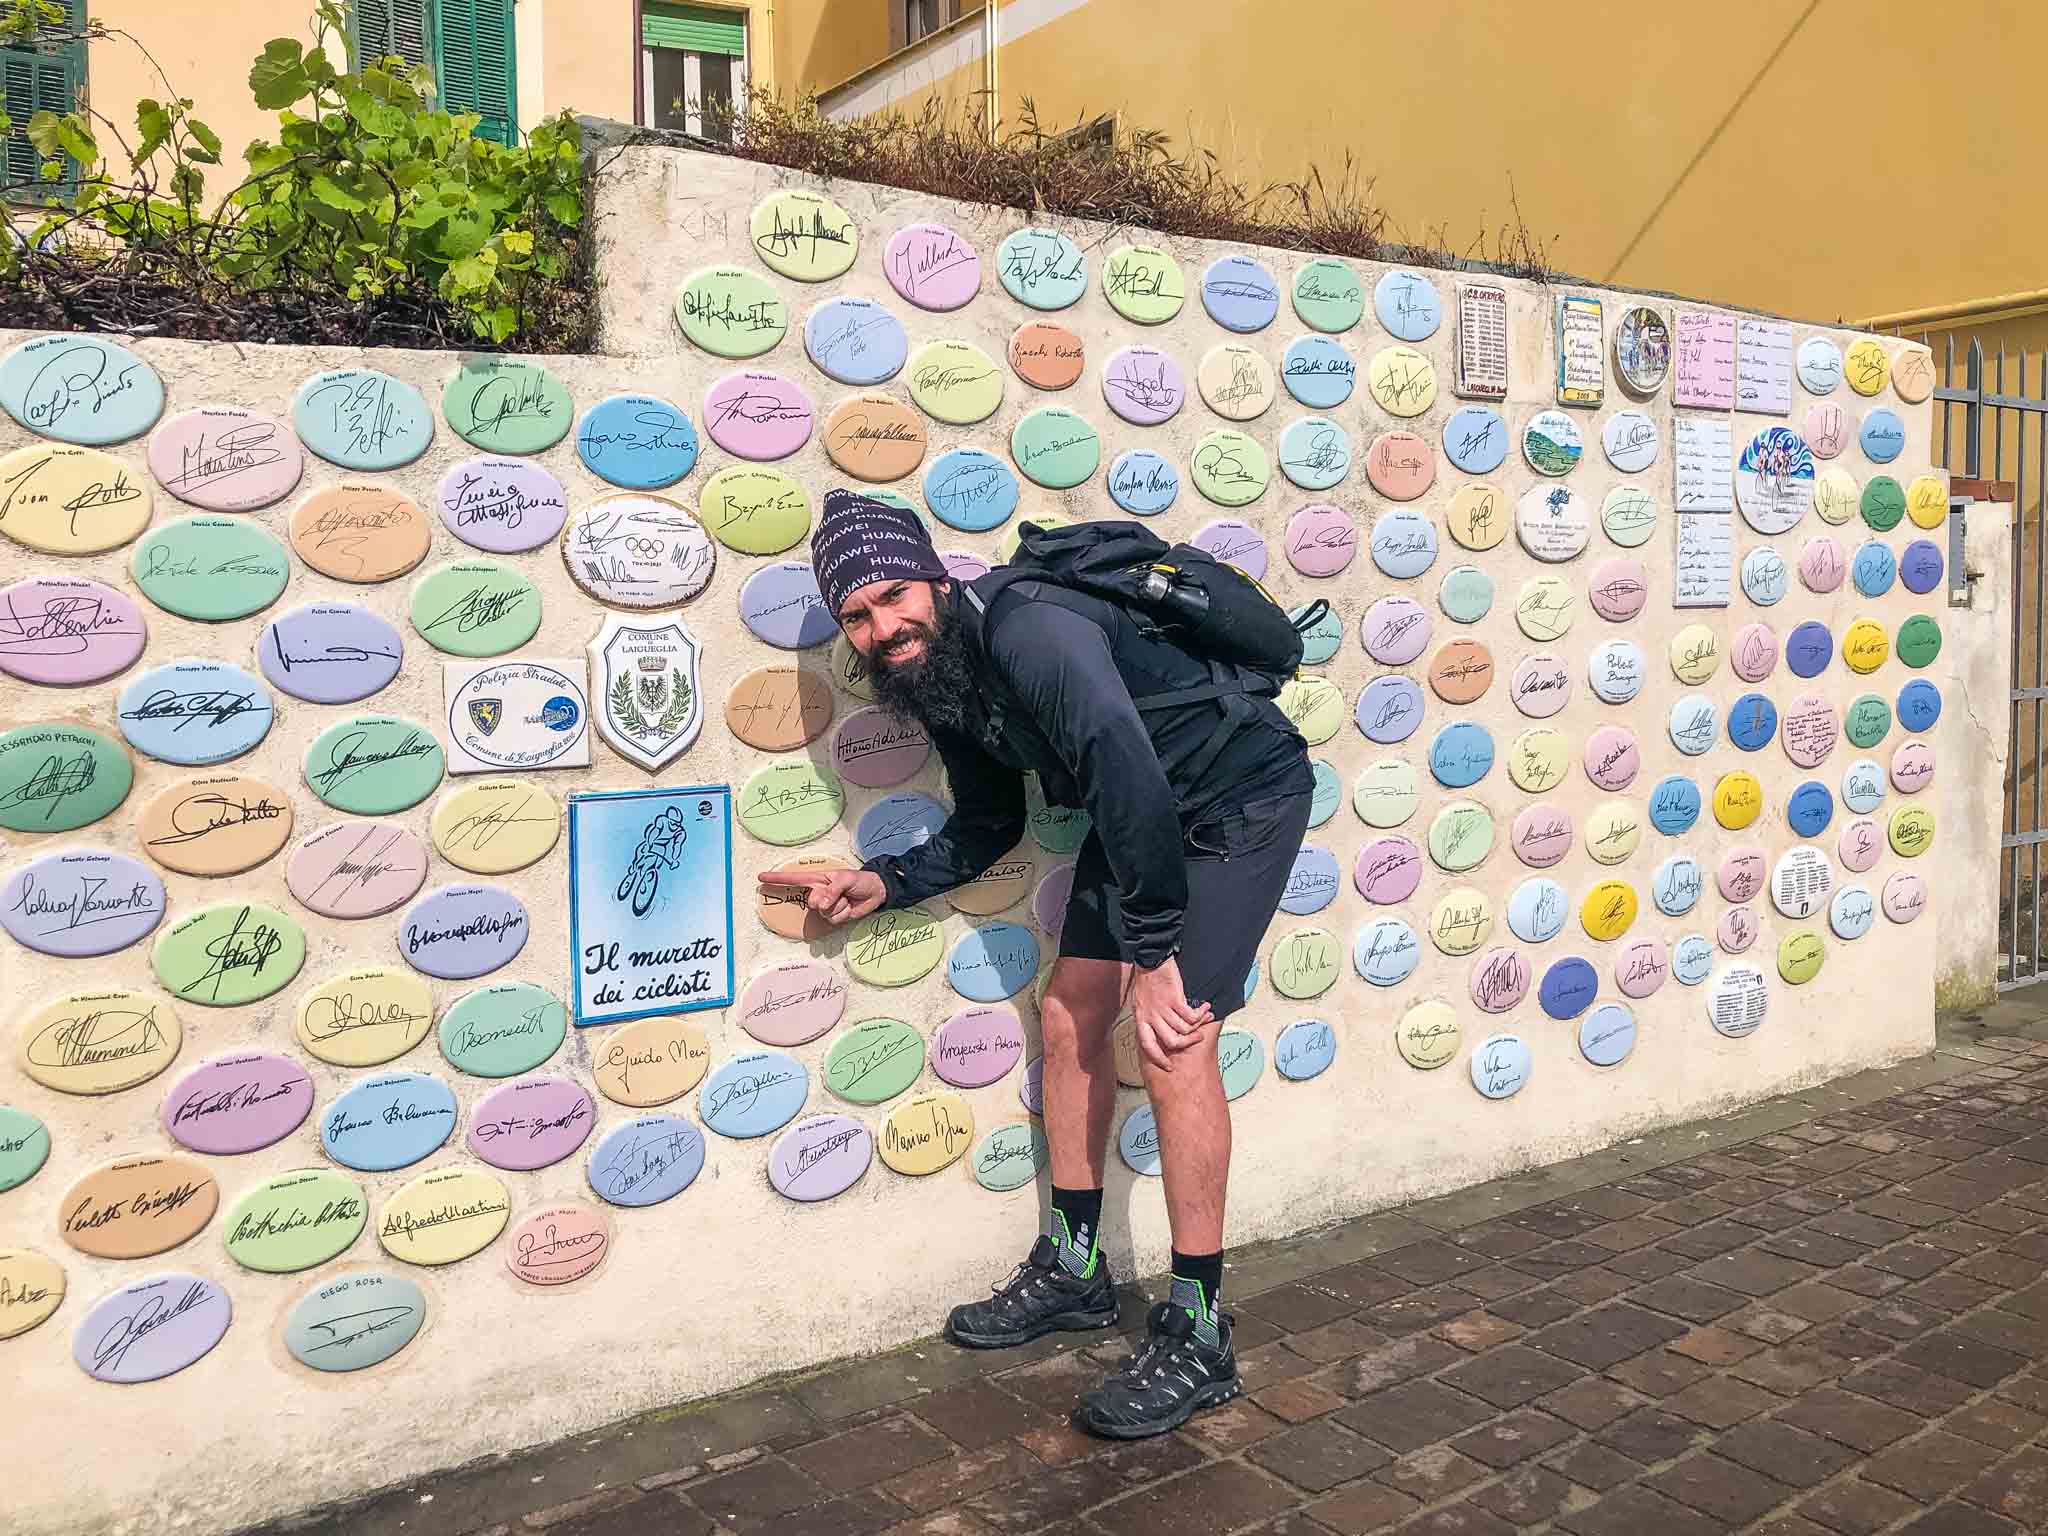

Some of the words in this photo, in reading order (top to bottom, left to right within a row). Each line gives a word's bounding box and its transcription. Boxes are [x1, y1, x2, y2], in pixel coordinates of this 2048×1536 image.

[820, 522, 870, 555] HUAWEI
[862, 532, 918, 545] HUAWEI
[824, 544, 878, 579] HUAWEI
[870, 556, 921, 570] HUAWEI
[838, 571, 886, 604] HUAWEI
[621, 644, 678, 654] LAIGUEGLIA
[472, 670, 520, 692] Polizia
[522, 666, 568, 690] Stradale
[465, 735, 502, 760] Comune
[585, 942, 620, 976] Il
[628, 936, 723, 968] muretto
[593, 980, 626, 1006] dei
[632, 968, 712, 1001] ciclisti
[383, 1211, 444, 1242] Alfredo
[320, 1282, 350, 1300] DIEGO
[355, 1276, 384, 1288] ROSA
